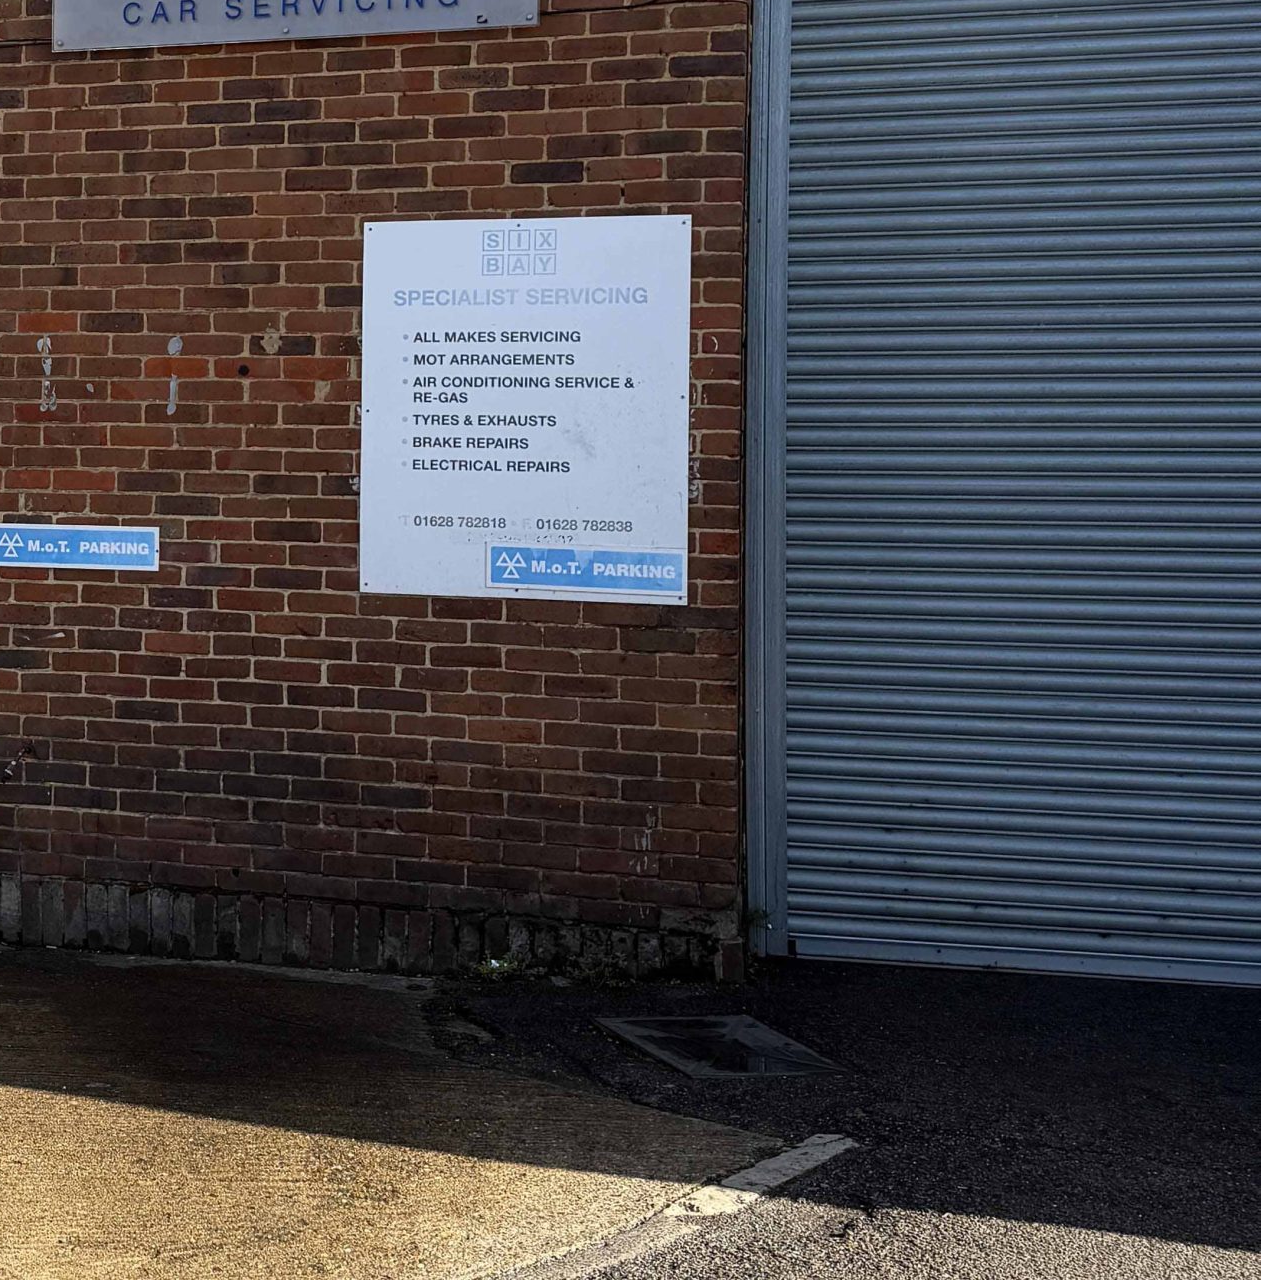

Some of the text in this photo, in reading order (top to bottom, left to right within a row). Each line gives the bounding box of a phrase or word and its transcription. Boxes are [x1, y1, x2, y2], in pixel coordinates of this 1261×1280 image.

[122, 0, 198, 26] CAR
[485, 230, 553, 249] SIX
[485, 255, 553, 273] BAY
[393, 287, 648, 307] SPECIALIST SERVICING
[413, 331, 581, 343] ALL MAKES SERVICING
[413, 354, 575, 366] MOT ARRANGEMENTS
[412, 376, 635, 389] AIR CONDITIONING SERVICE &
[413, 392, 468, 404] RE-GAS
[412, 414, 557, 427] TYRES & EXHAUSTS
[412, 437, 529, 450] BRAKE REPAIRS
[412, 459, 571, 473] ELECTRICAL REPAIRS
[413, 515, 454, 528] 01628
[457, 516, 507, 529] 782818
[536, 518, 578, 531] 01628
[582, 519, 633, 533] 782838
[27, 539, 150, 556] M.o.T. PARKING
[531, 560, 676, 579] M.o.T. PARKING
